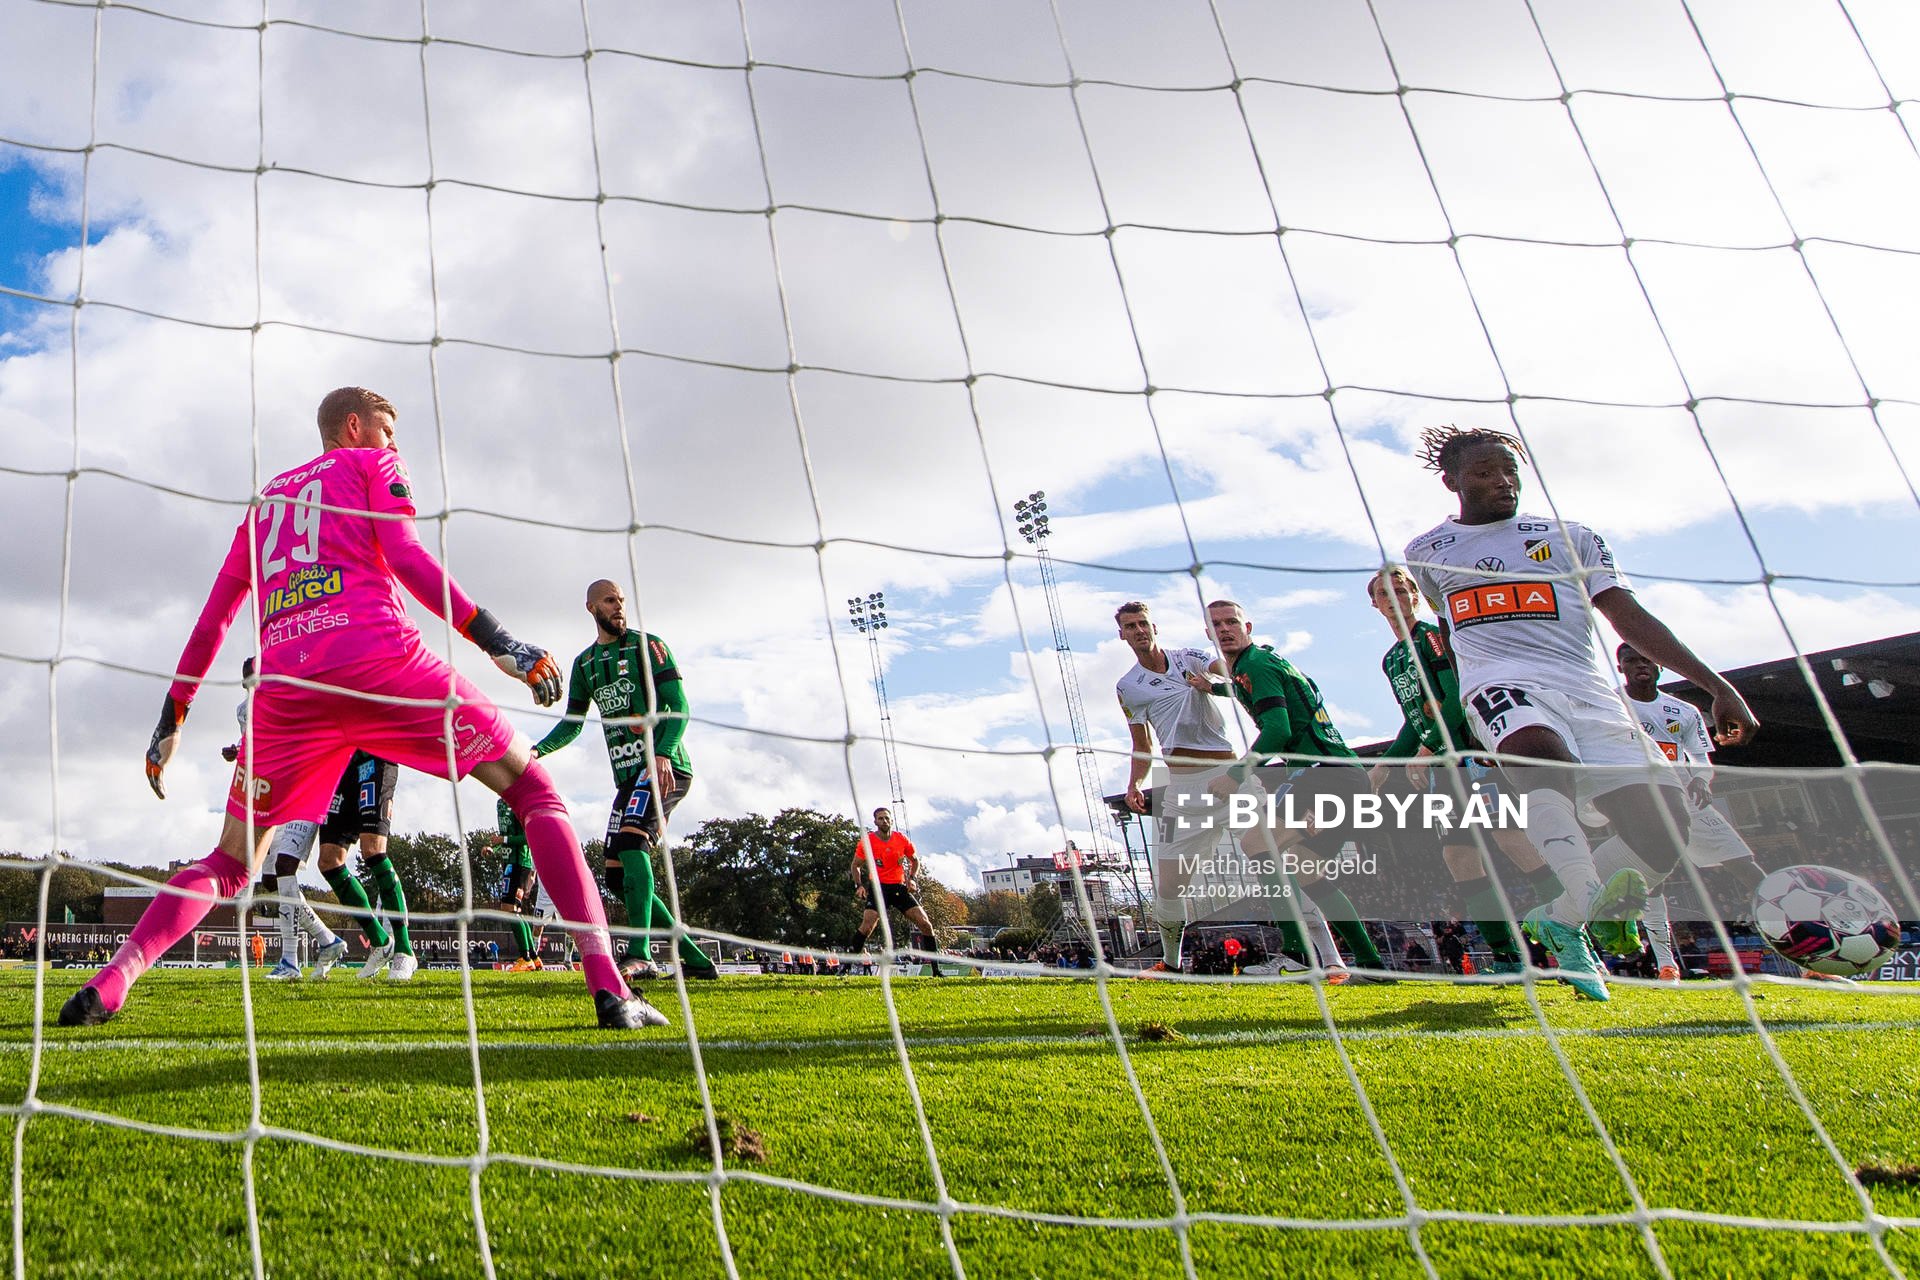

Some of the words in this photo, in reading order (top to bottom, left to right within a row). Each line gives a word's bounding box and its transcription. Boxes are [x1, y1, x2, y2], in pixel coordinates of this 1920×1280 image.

[259, 479, 322, 582] 29
[289, 564, 327, 590] Gekås
[267, 603, 329, 633] NORDIC
[1490, 716, 1507, 738] 37
[47, 932, 81, 944] VARBERG
[84, 933, 112, 944] ENERGI
[217, 935, 251, 947] VARBEG
